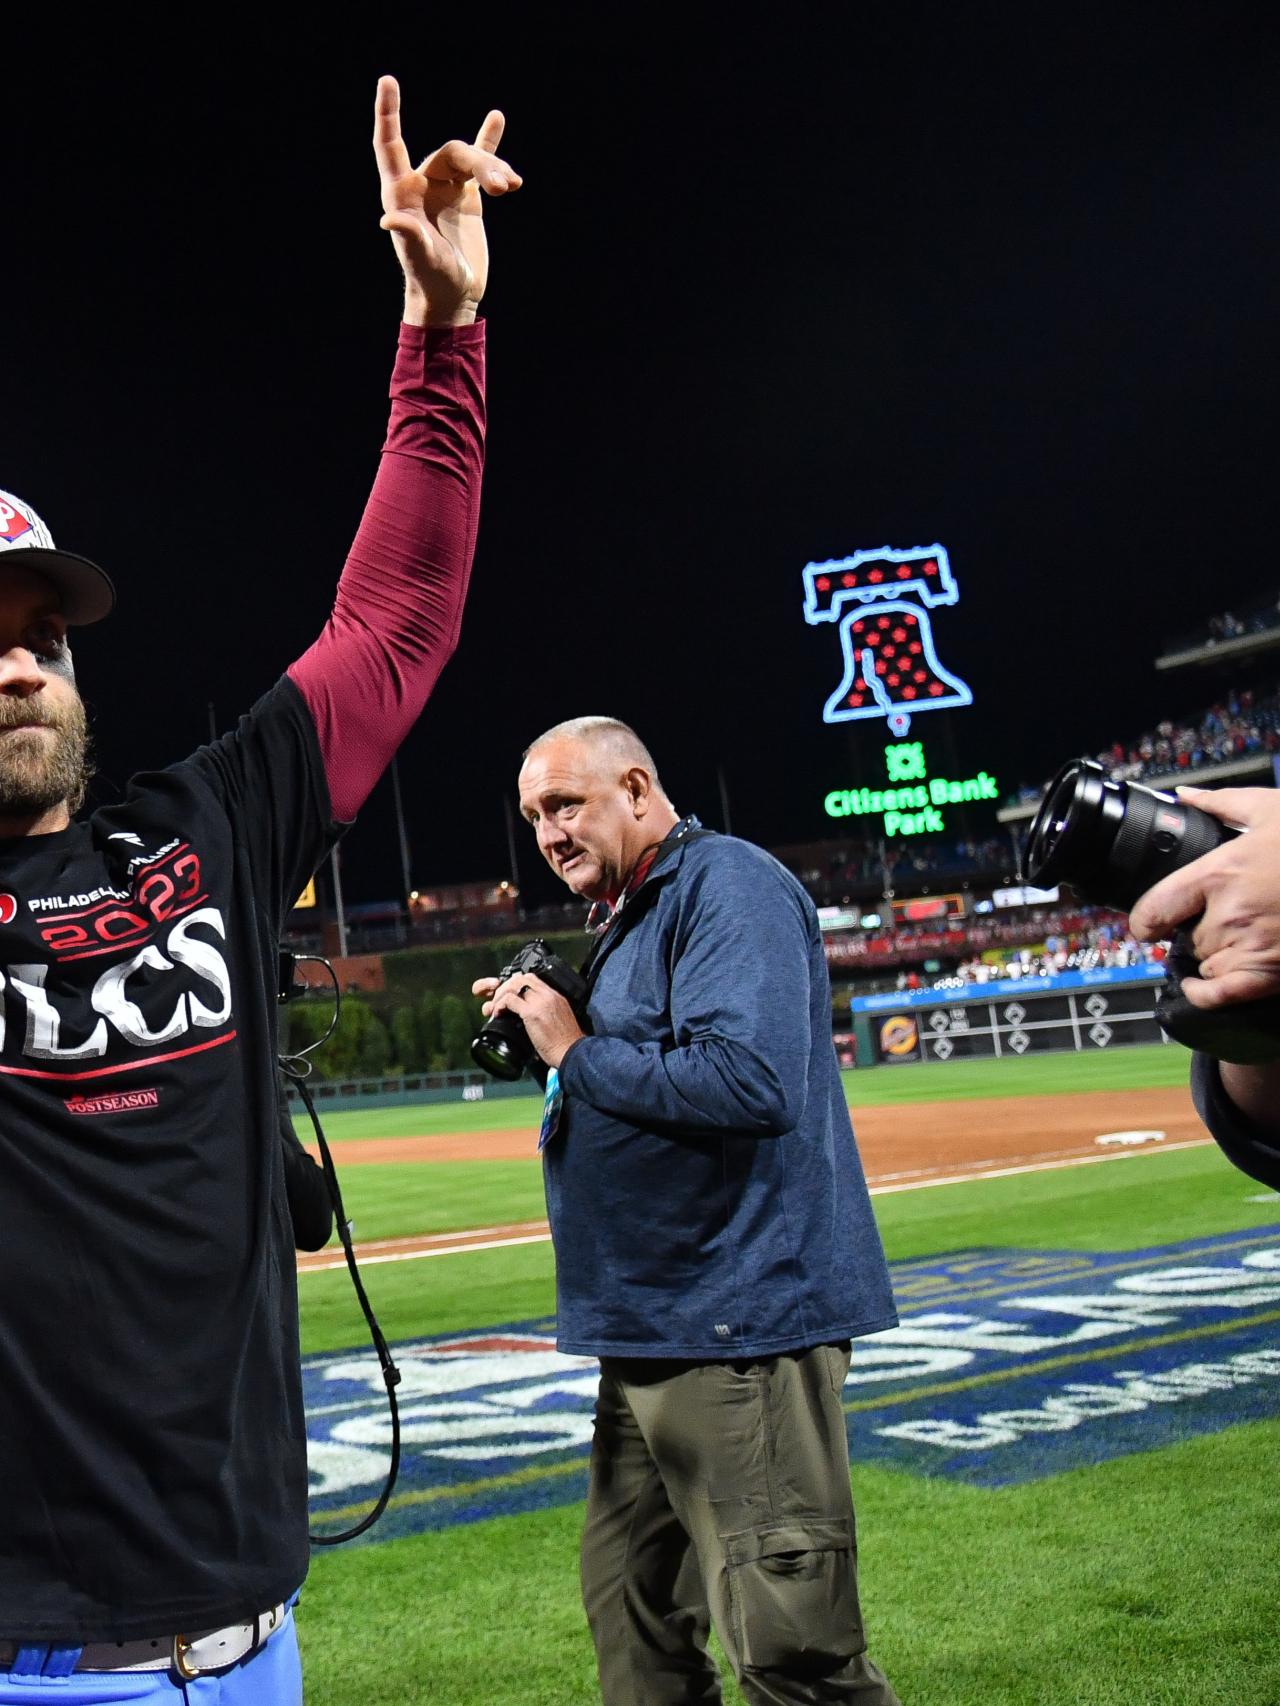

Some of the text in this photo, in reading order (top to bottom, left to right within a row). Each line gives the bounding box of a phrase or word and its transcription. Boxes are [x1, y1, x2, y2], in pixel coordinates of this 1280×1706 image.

[824, 771, 999, 818] Citizens Bank
[883, 805, 945, 837] Park
[40, 853, 201, 951] 2023
[66, 1091, 159, 1113] POSTSEASON
